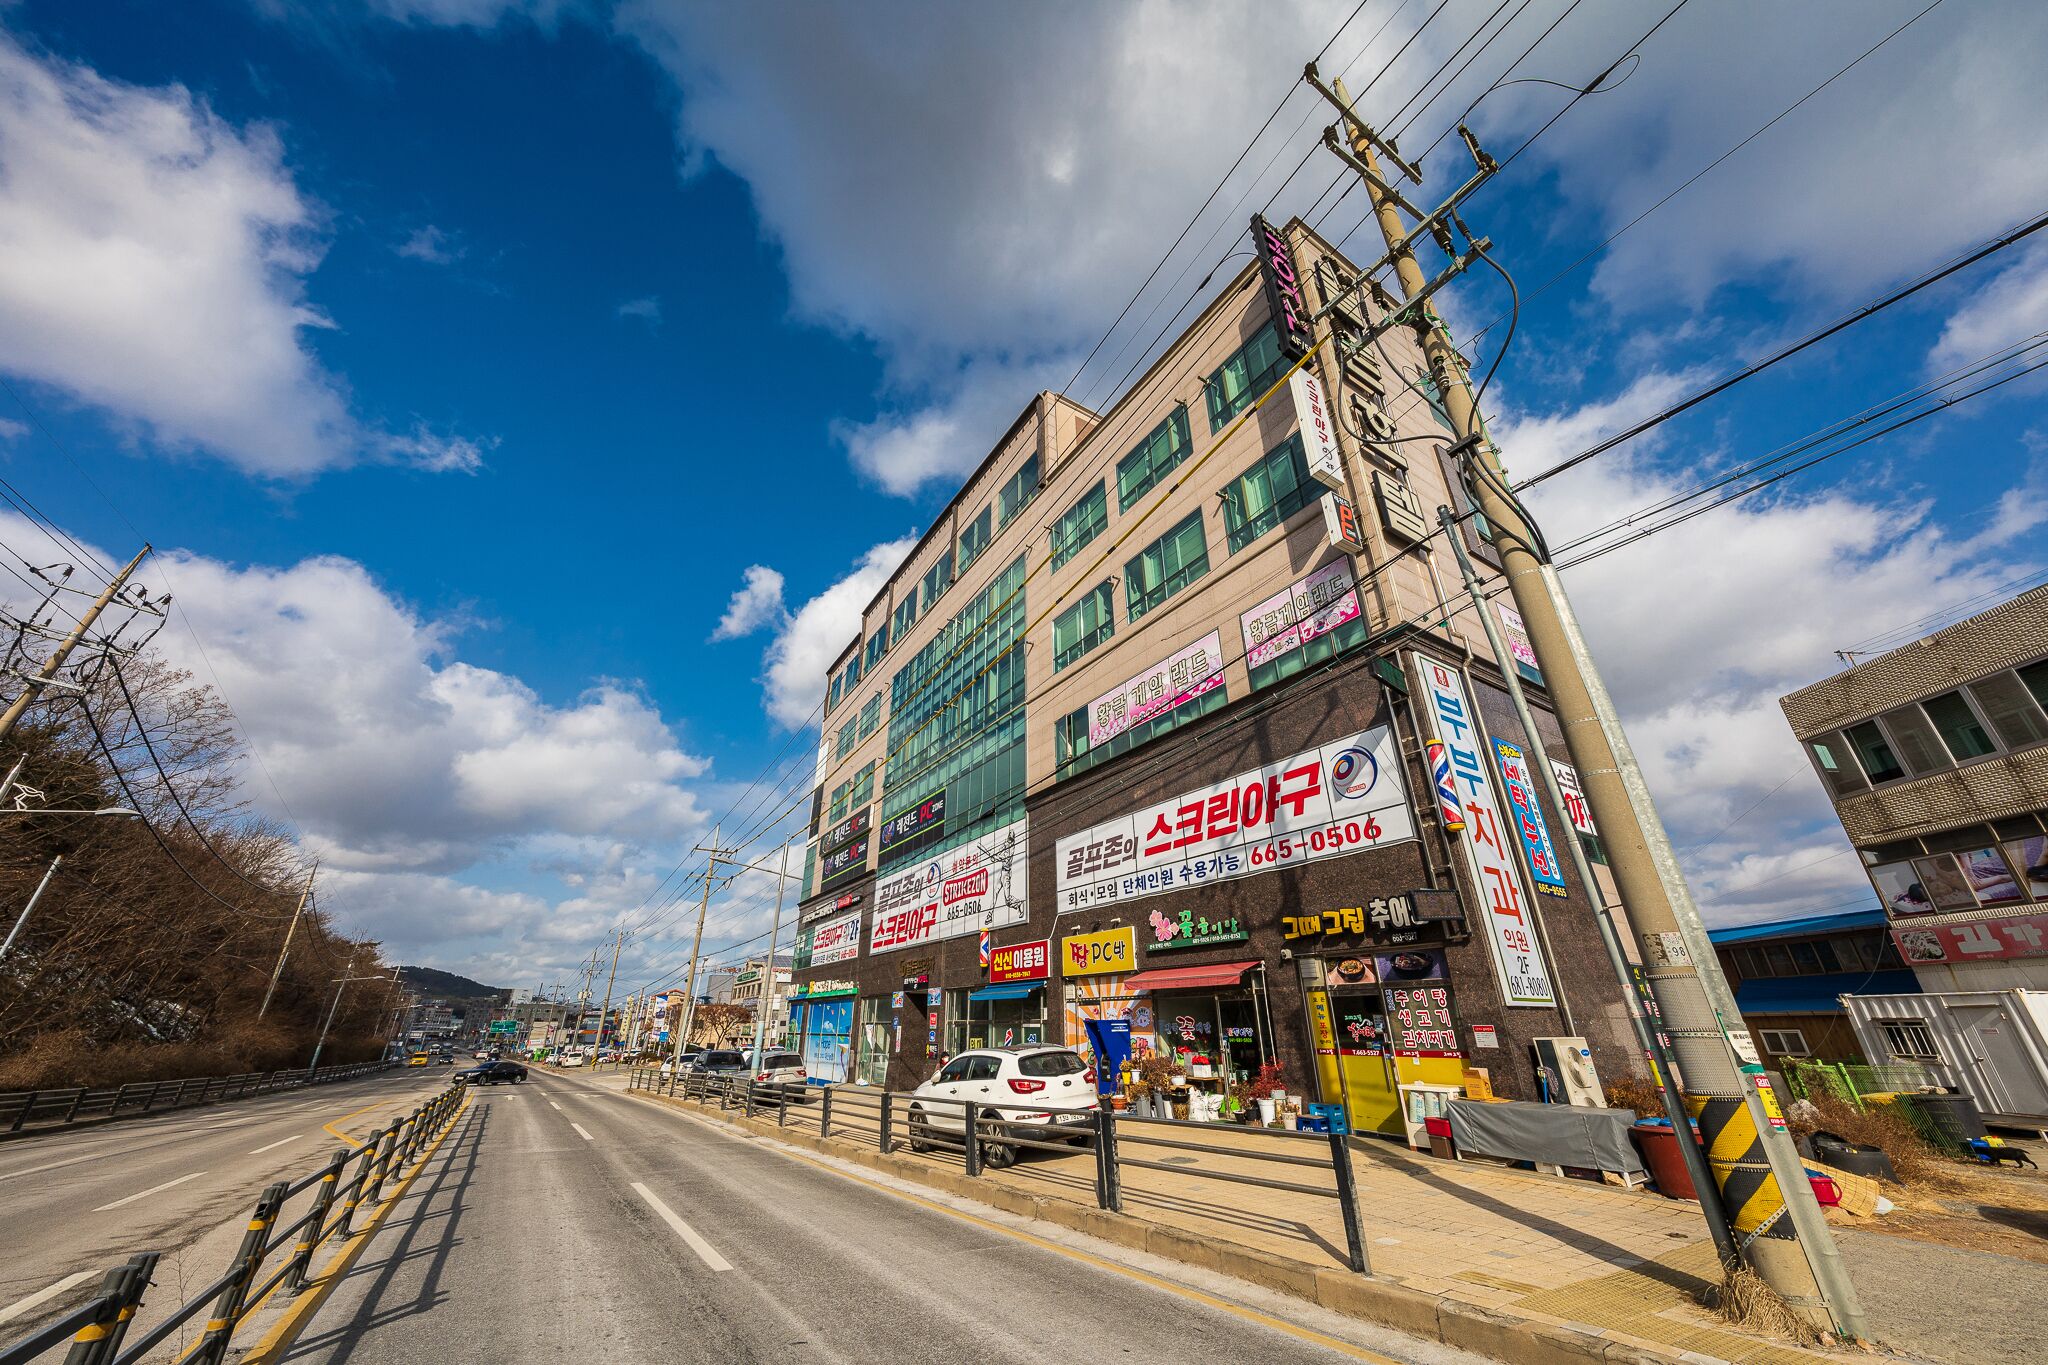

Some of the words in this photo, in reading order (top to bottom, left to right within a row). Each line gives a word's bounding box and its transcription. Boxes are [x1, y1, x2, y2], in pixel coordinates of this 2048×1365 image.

[1306, 379, 1329, 443] 스크린야구
[896, 810, 917, 835] 레전드
[920, 801, 933, 823] PC
[932, 800, 944, 813] ZONE
[1066, 834, 1139, 880] 골프존의
[1144, 761, 1321, 858] 스크린야구
[1434, 689, 1525, 926] 부부치과
[1503, 760, 1550, 877] 세탁수선
[851, 816, 860, 833] PC
[850, 843, 859, 860] PC
[1123, 867, 1175, 896] 단체인원
[1179, 853, 1241, 882] 수용가능
[1251, 817, 1382, 867] 665-0506
[943, 870, 987, 904] STRIKEZON
[873, 902, 939, 949] 스크린야구
[947, 899, 982, 920] 665-0506
[1369, 896, 1429, 930] 추어
[813, 924, 843, 950] 스크린야구
[849, 918, 860, 941] 2F
[1504, 928, 1530, 953] 의원
[993, 945, 1045, 972] 신신이용원
[1517, 955, 1530, 975] 2F
[1511, 975, 1549, 997] 681-8080
[1176, 1016, 1195, 1041] 꽃
[1402, 1030, 1458, 1049] 김치찌개
